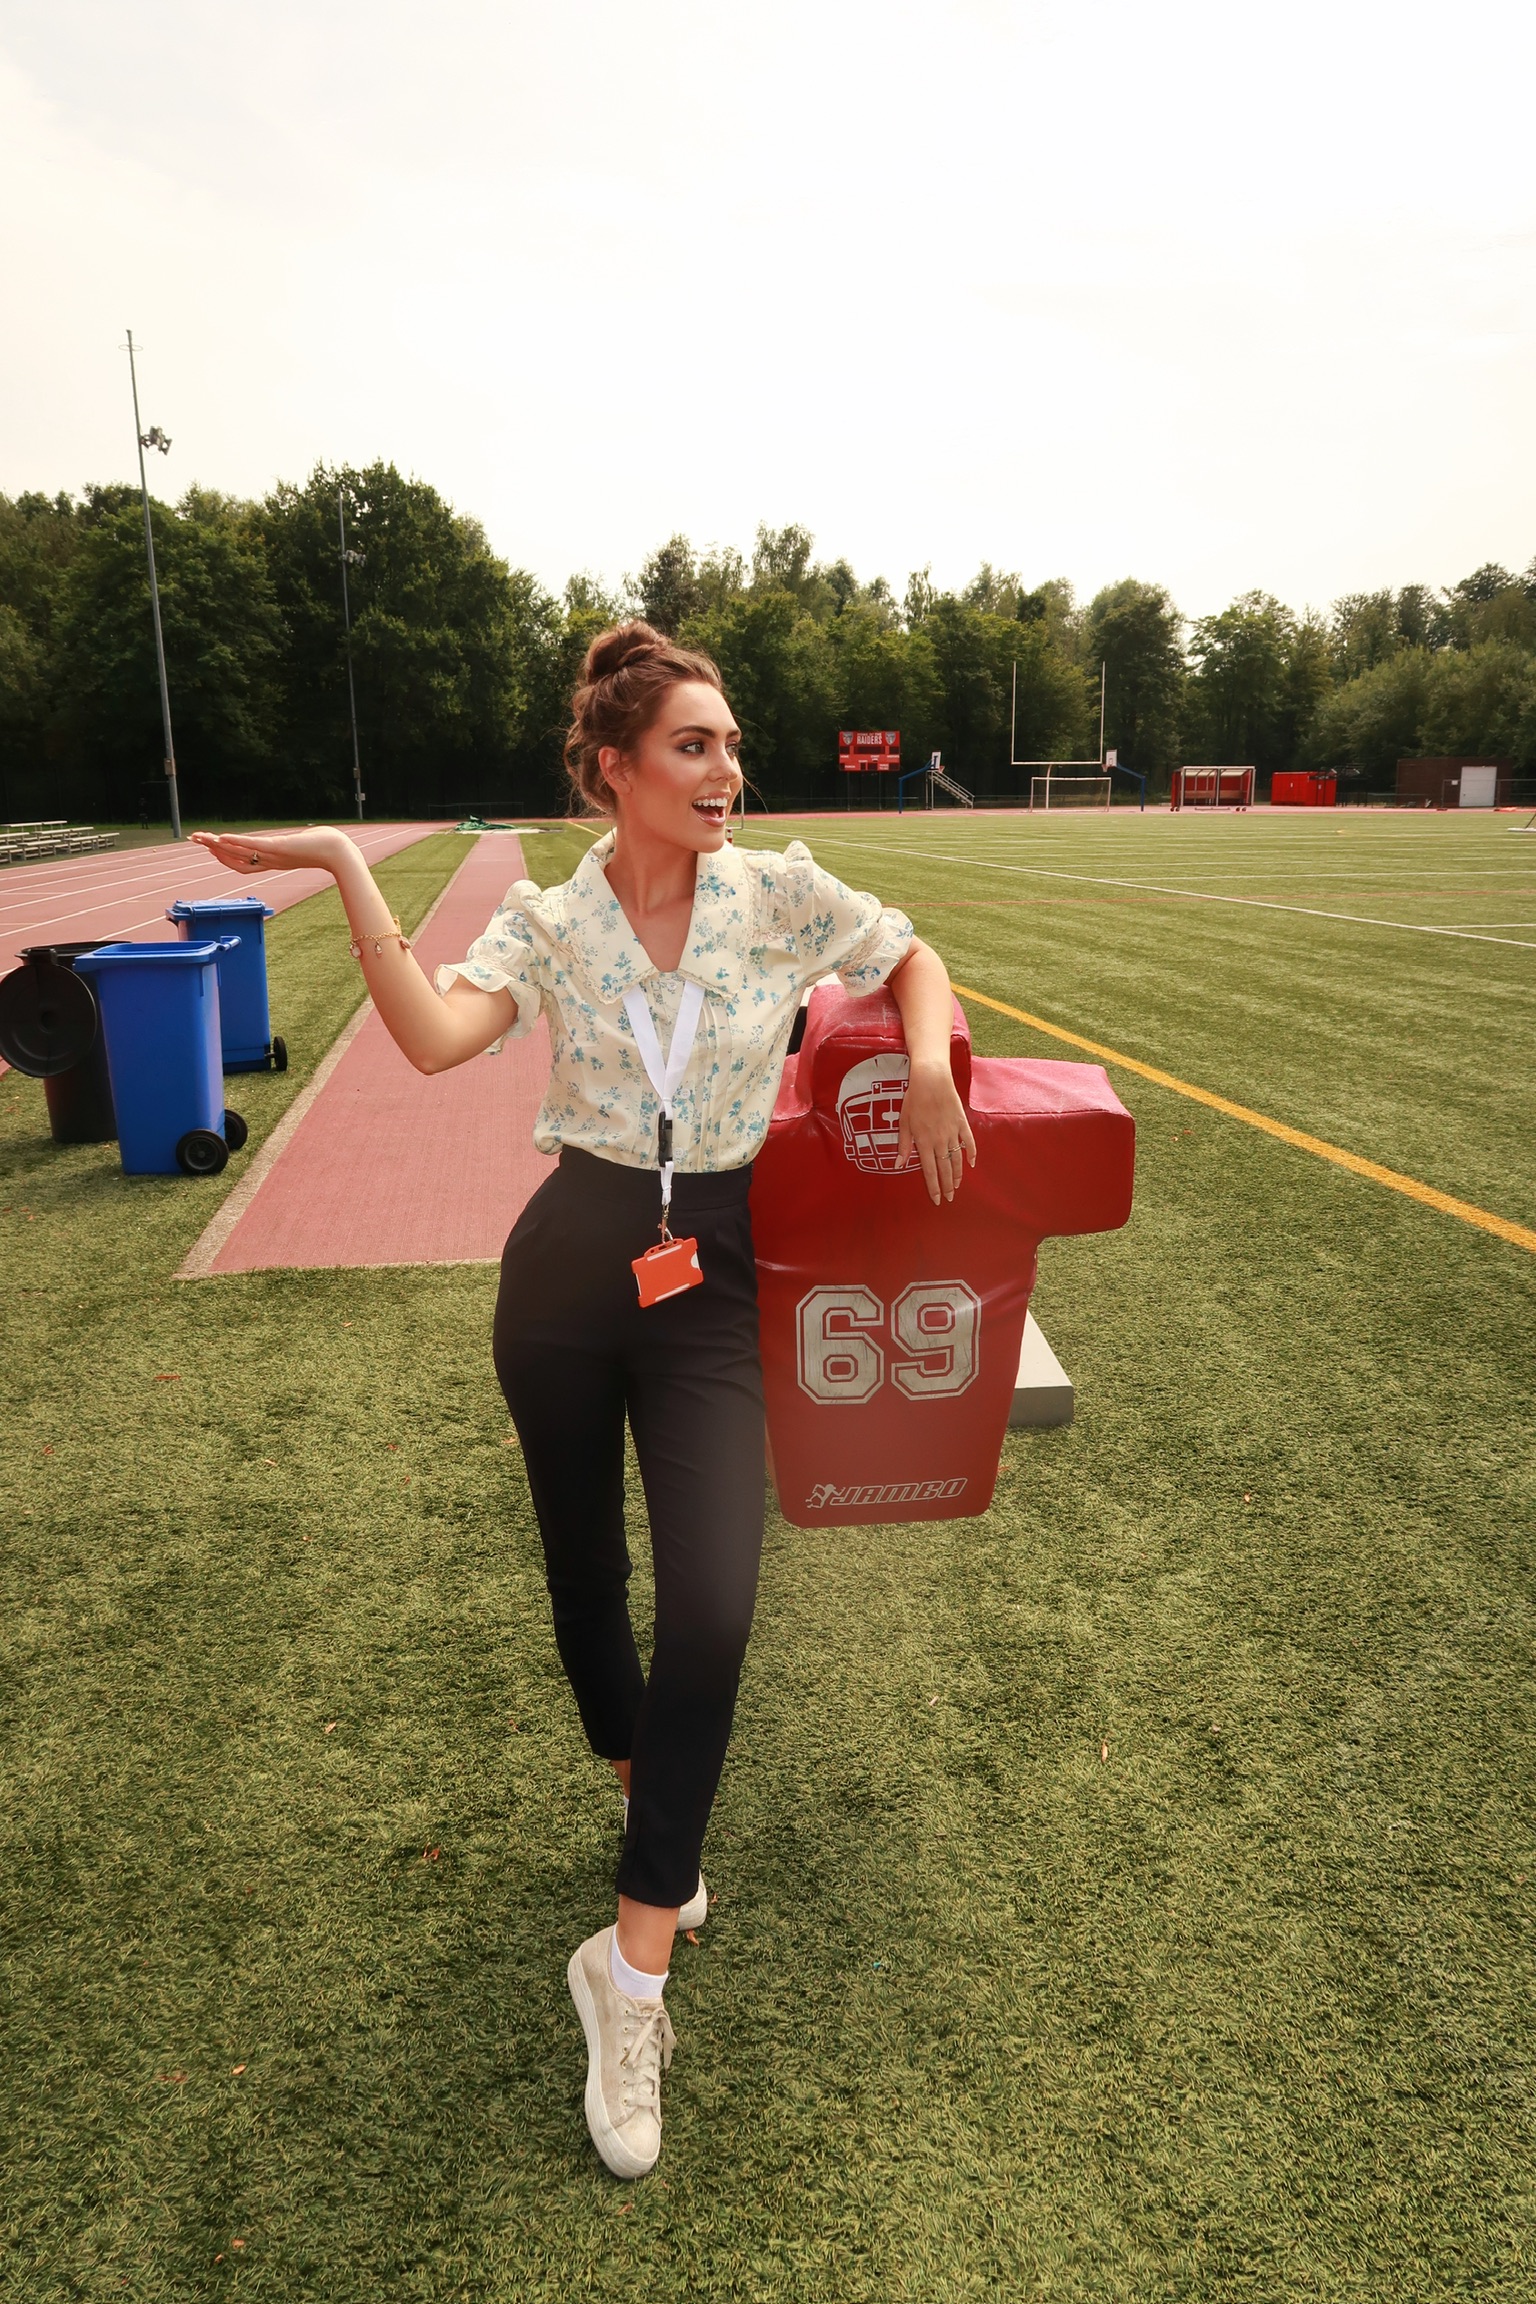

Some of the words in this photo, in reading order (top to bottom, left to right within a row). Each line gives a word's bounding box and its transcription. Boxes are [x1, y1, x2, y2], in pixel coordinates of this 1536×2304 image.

[857, 736, 882, 744] RAIDERS
[796, 1279, 981, 1404] 69
[829, 1478, 968, 1506] JAMBO
